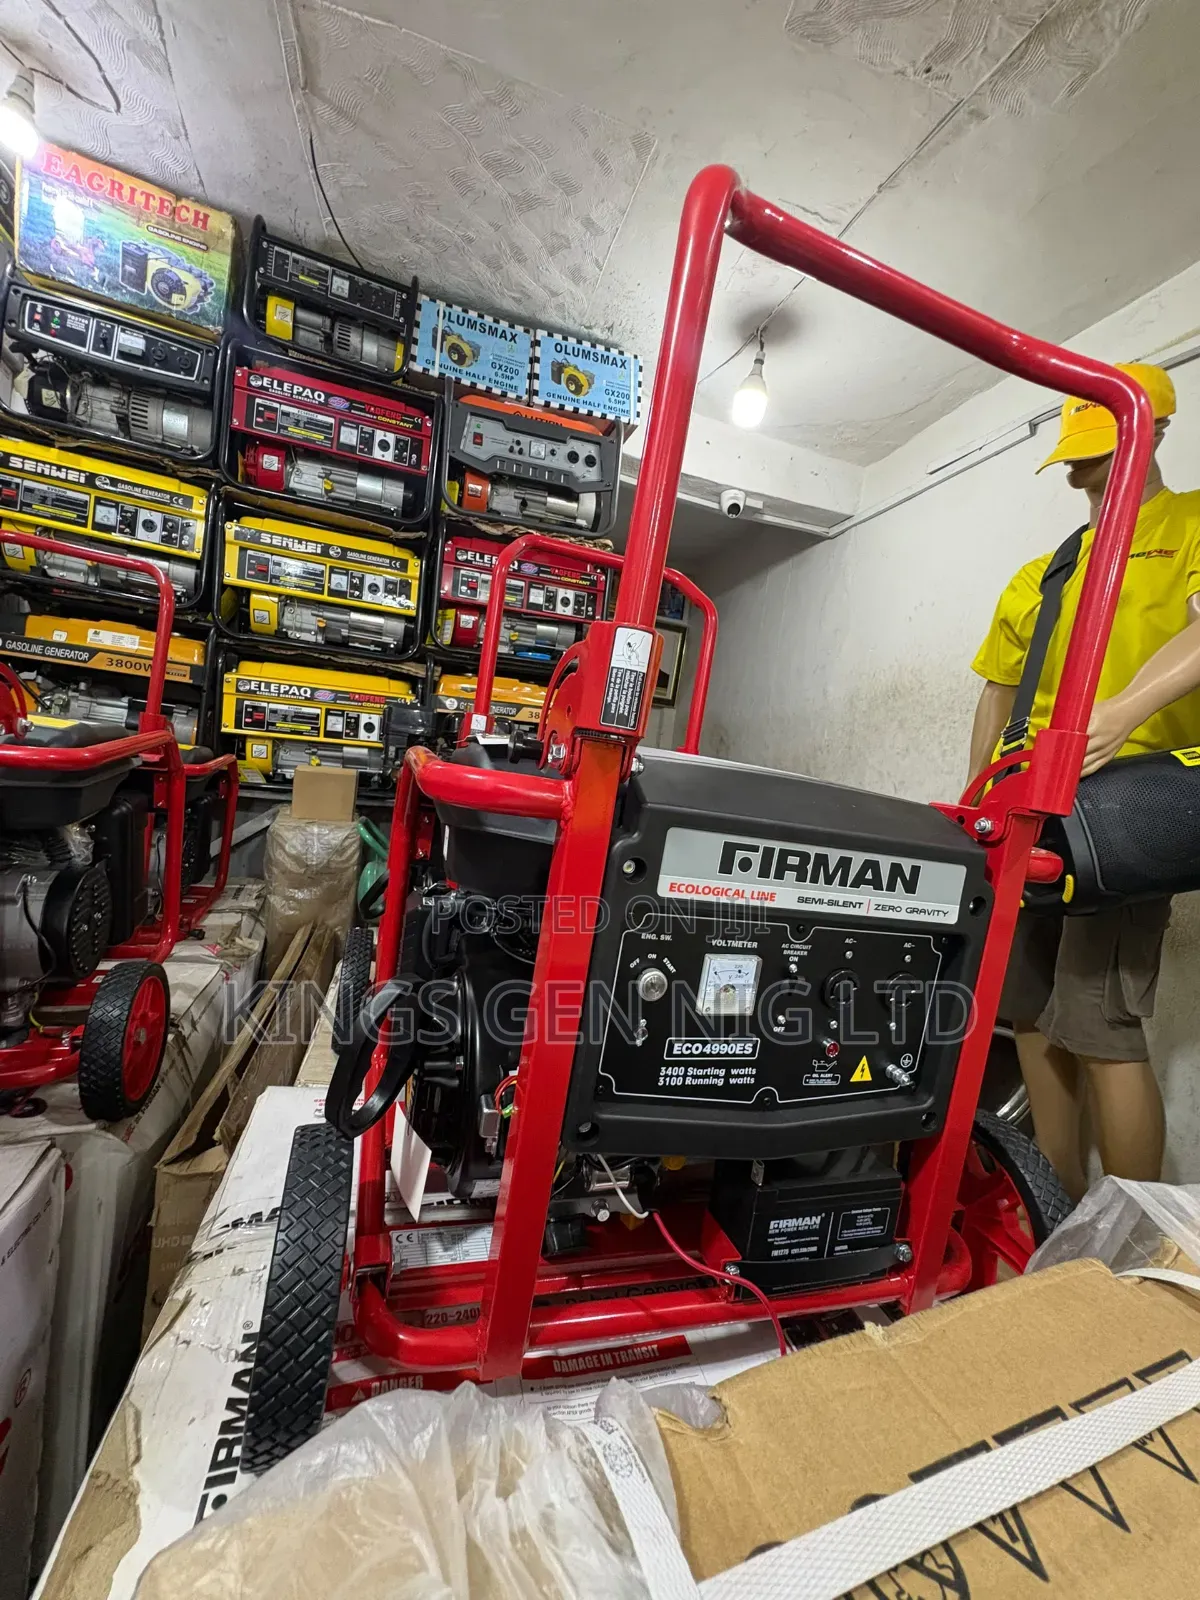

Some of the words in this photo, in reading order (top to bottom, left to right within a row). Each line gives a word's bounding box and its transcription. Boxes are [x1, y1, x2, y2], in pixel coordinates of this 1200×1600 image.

[436, 307, 518, 344] OLUMSMAX
[554, 342, 627, 369] OLUMSMAX
[425, 358, 463, 374] GENUINE
[465, 370, 487, 381] HALF
[489, 378, 519, 391] ENGINE
[491, 361, 520, 376] GX200
[494, 371, 515, 381] 6.5HP
[263, 376, 325, 403] ELEPAQ
[604, 388, 630, 400] GX200
[546, 391, 580, 404] GENUINE
[582, 400, 601, 408] HALF
[603, 404, 630, 415] ENGINE
[377, 416, 414, 429] CONSTANT
[8, 456, 86, 484] SENWEI
[117, 482, 142, 494] GASOLINE
[142, 487, 171, 500] GENERATOR
[260, 533, 322, 555] SENWEI
[347, 551, 367, 560] GASOLINE
[367, 554, 390, 564] GENERATOR
[467, 551, 519, 570] ELEPQ
[561, 576, 591, 586] CONSTANT
[6, 640, 43, 654] GASOLINE
[44, 644, 90, 661] GENERATOR
[250, 680, 311, 698] ELEPAQ
[717, 839, 922, 896] FIRMAN
[668, 882, 747, 899] ECOLOGICAL
[749, 888, 778, 903] LINE
[796, 895, 864, 910] SEMI-SILENT
[873, 903, 903, 914] ZERO
[905, 906, 950, 918] GRAVITY
[641, 933, 659, 941] ENG.
[711, 939, 758, 949] VOLTMETER
[629, 957, 641, 969] OFF
[662, 957, 677, 974] START
[673, 1042, 754, 1055] ECO4990ES
[659, 1066, 685, 1076] 3400
[686, 1067, 726, 1077] Starting
[730, 1067, 757, 1075] watts
[658, 1076, 683, 1086] 3100
[684, 1077, 725, 1086] Running
[769, 1215, 821, 1230] FIRMAN
[395, 1232, 414, 1244] CE
[552, 1353, 601, 1374] DAMAGE
[600, 1352, 614, 1368] IN
[614, 1344, 660, 1363] TRANSIT
[371, 1375, 424, 1398] DANGER
[193, 1331, 259, 1528] FIRMAN
